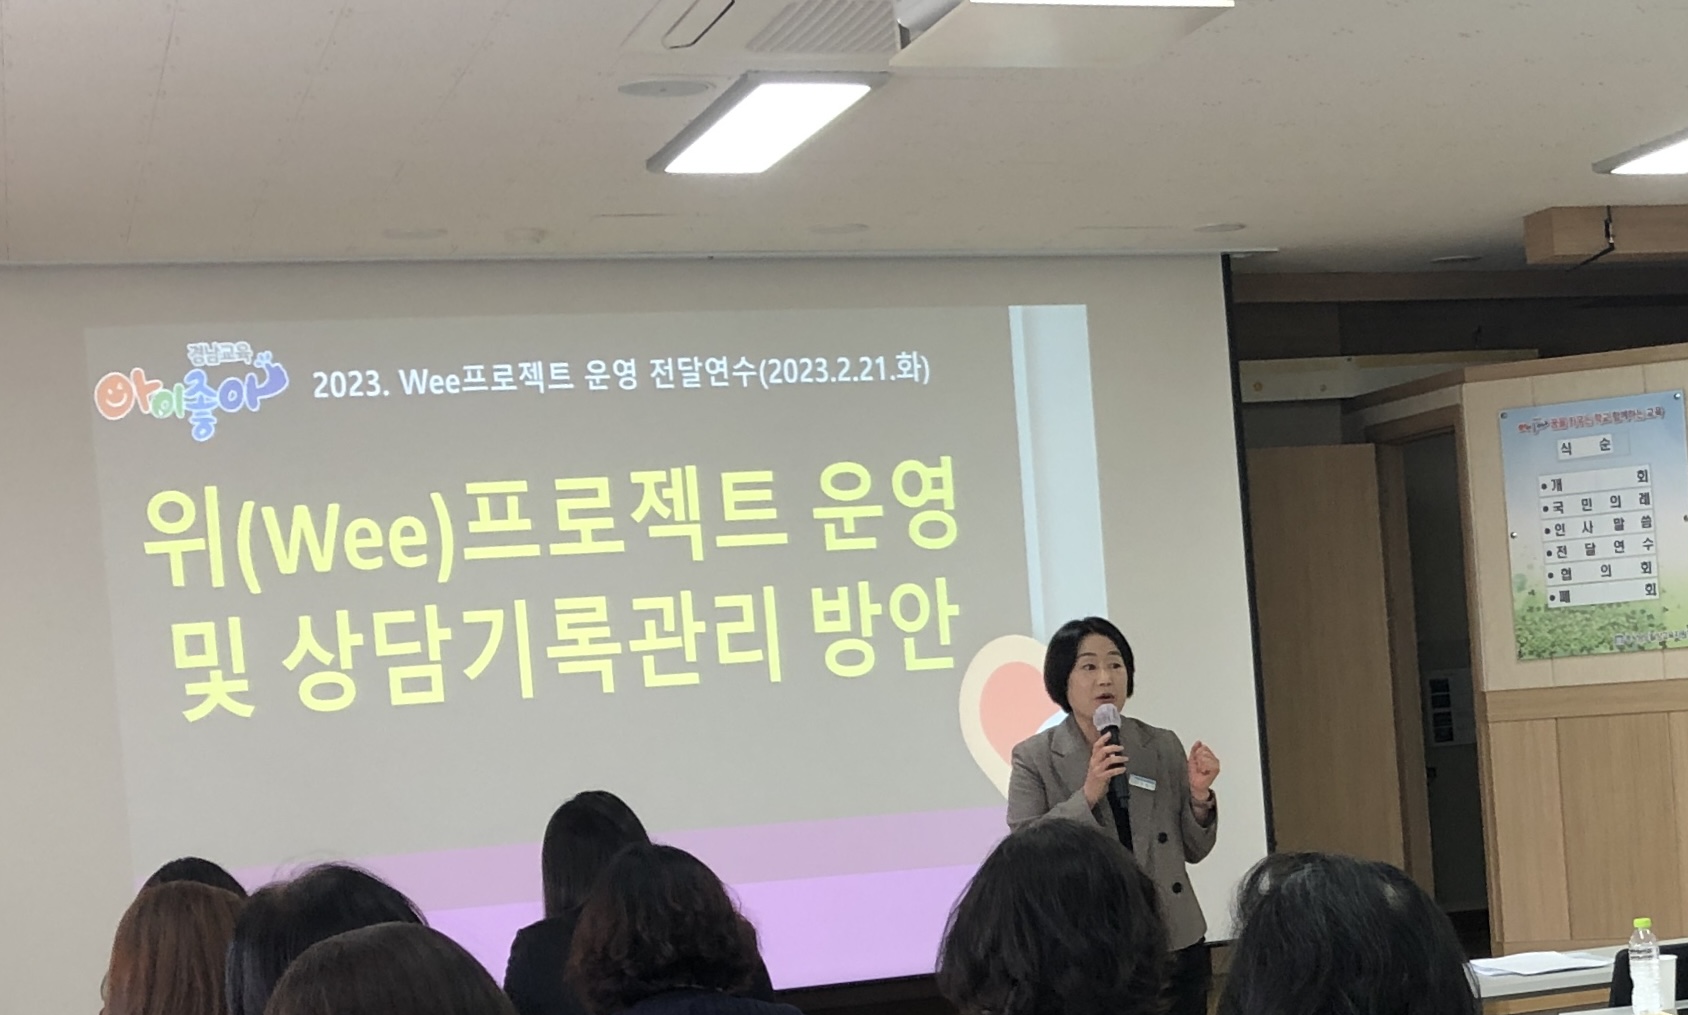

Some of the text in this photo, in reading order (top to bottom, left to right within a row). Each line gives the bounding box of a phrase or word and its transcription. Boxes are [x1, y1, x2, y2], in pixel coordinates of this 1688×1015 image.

[187, 341, 253, 366] 경남교육
[313, 350, 931, 398] 2023. Wee프로젝트 운영 전달연수(2023.2.21.화)
[143, 456, 959, 594] 위(Wee)프로젝트 운영
[172, 577, 961, 722] 및 상담기록관리 방안
